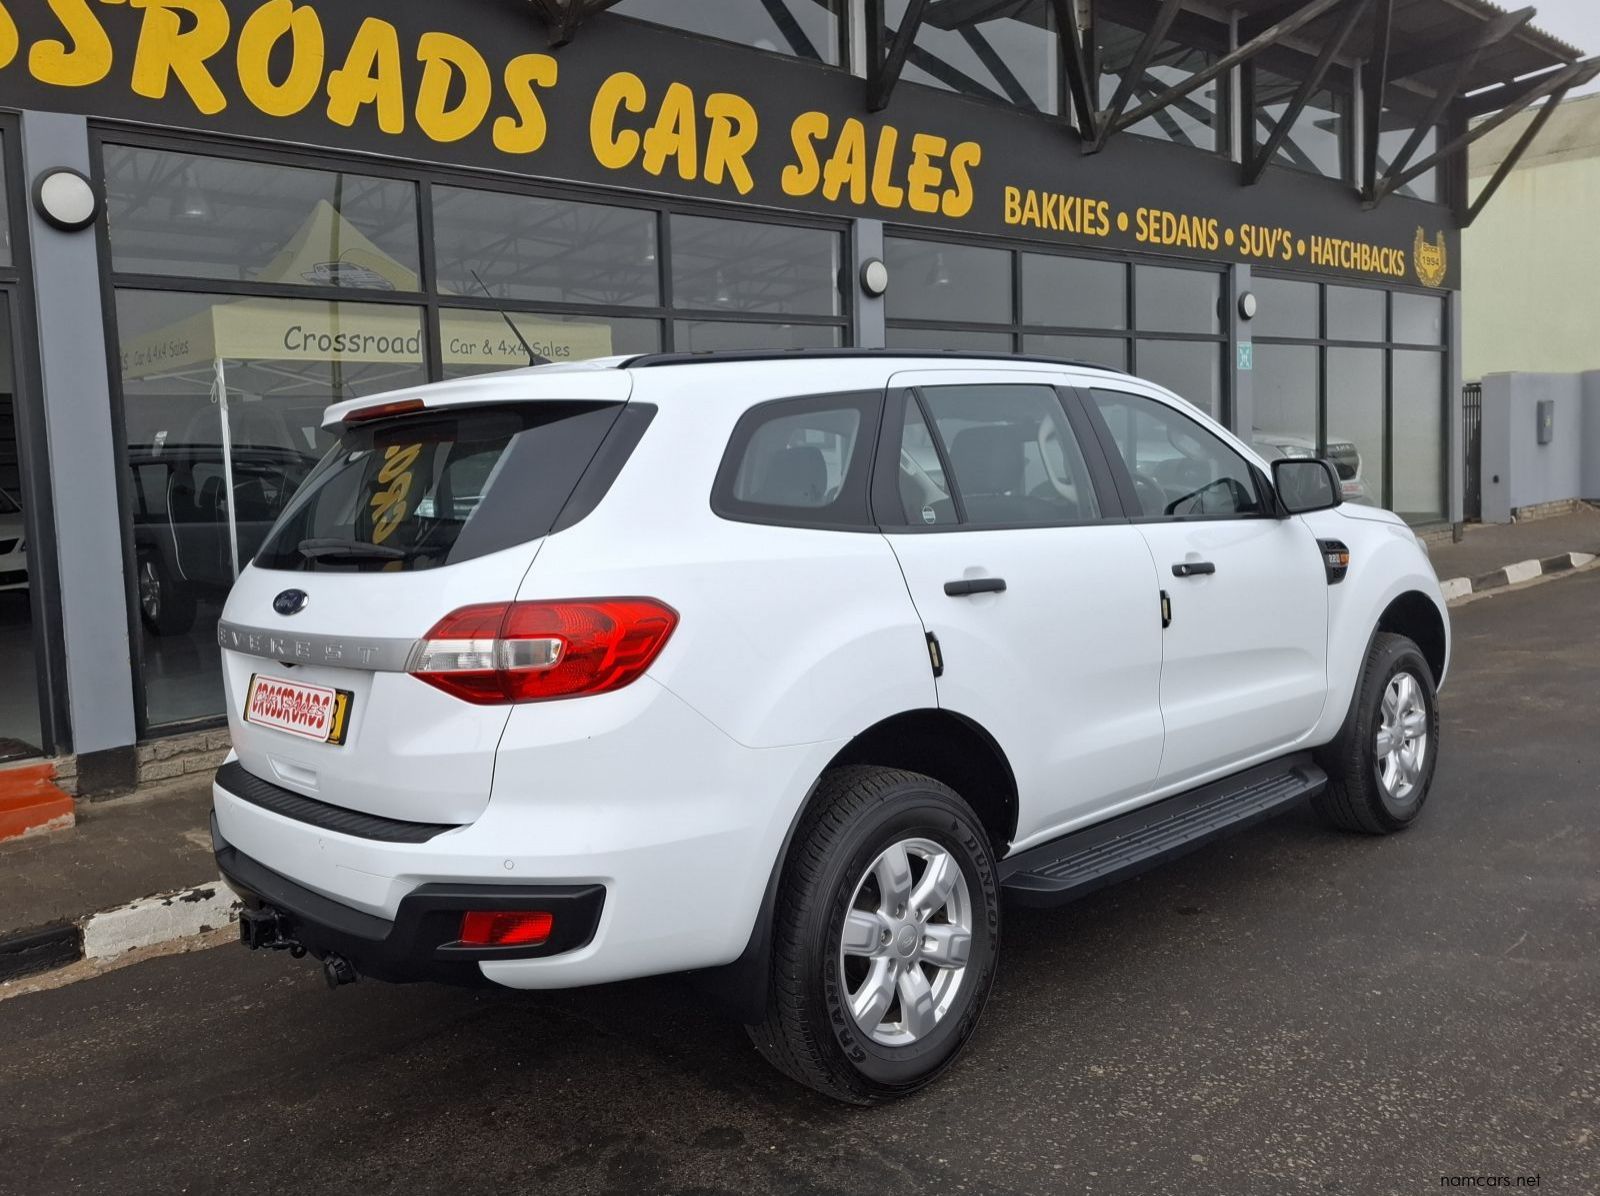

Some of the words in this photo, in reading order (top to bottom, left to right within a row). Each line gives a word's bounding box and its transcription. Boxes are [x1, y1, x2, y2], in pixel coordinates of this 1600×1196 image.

[0, 0, 558, 155] SROADS
[589, 71, 759, 196] CAR
[780, 110, 982, 218] SALES
[1003, 185, 1110, 237] BAKKIES
[1135, 207, 1219, 251] SEDANS
[1239, 224, 1293, 262] SUV'S
[1310, 235, 1405, 277] HATCHBACKS
[284, 325, 421, 354] Crossroad
[449, 338, 477, 355] Car
[482, 339, 493, 355] &
[498, 340, 526, 356] 4x4
[532, 341, 570, 357] Sales
[218, 629, 380, 664] EVEREST
[252, 682, 330, 729] CROSSROADS
[963, 836, 998, 952] DUNLOP
